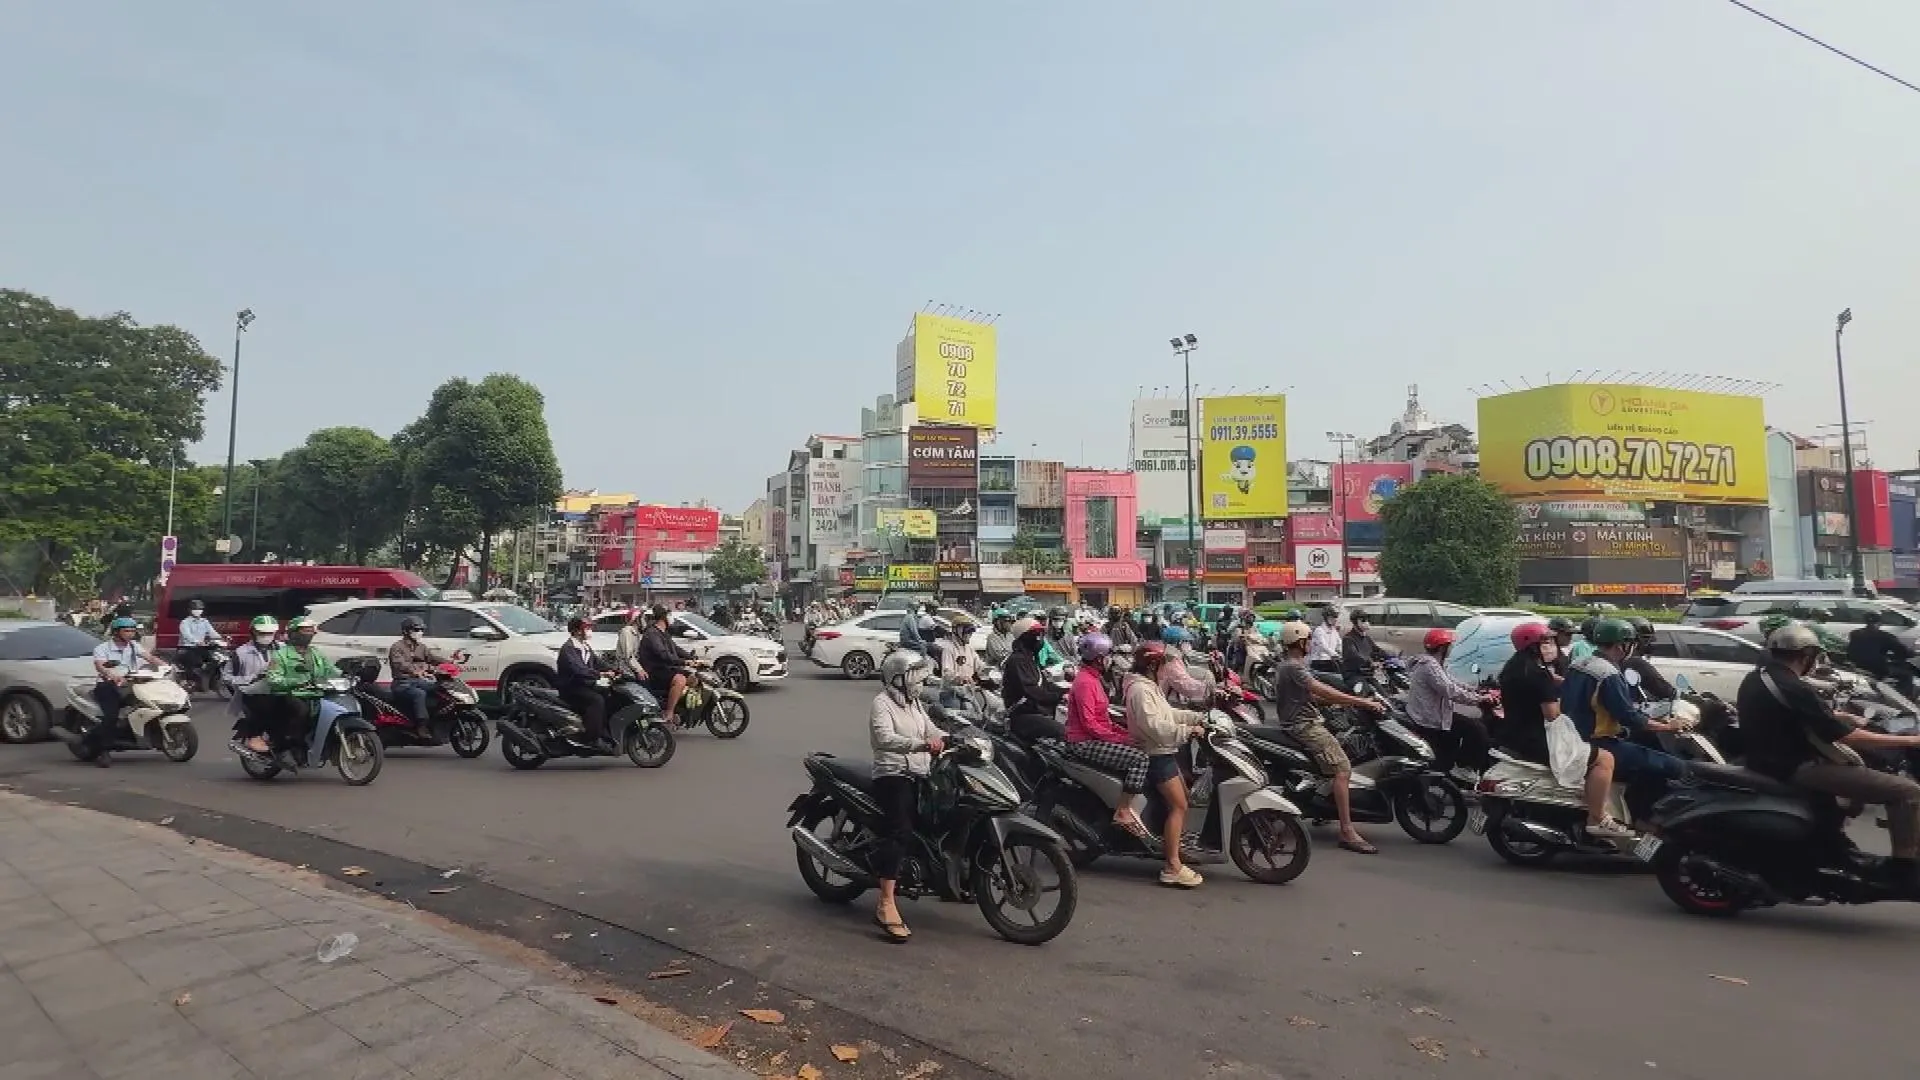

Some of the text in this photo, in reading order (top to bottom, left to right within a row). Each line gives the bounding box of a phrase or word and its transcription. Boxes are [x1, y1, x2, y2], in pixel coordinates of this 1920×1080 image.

[947, 362, 966, 378] 70
[948, 380, 966, 398] 72
[948, 400, 965, 416] 71
[1211, 424, 1278, 440] 0911.39.5555
[1525, 436, 1735, 486] 0908.70.72.71
